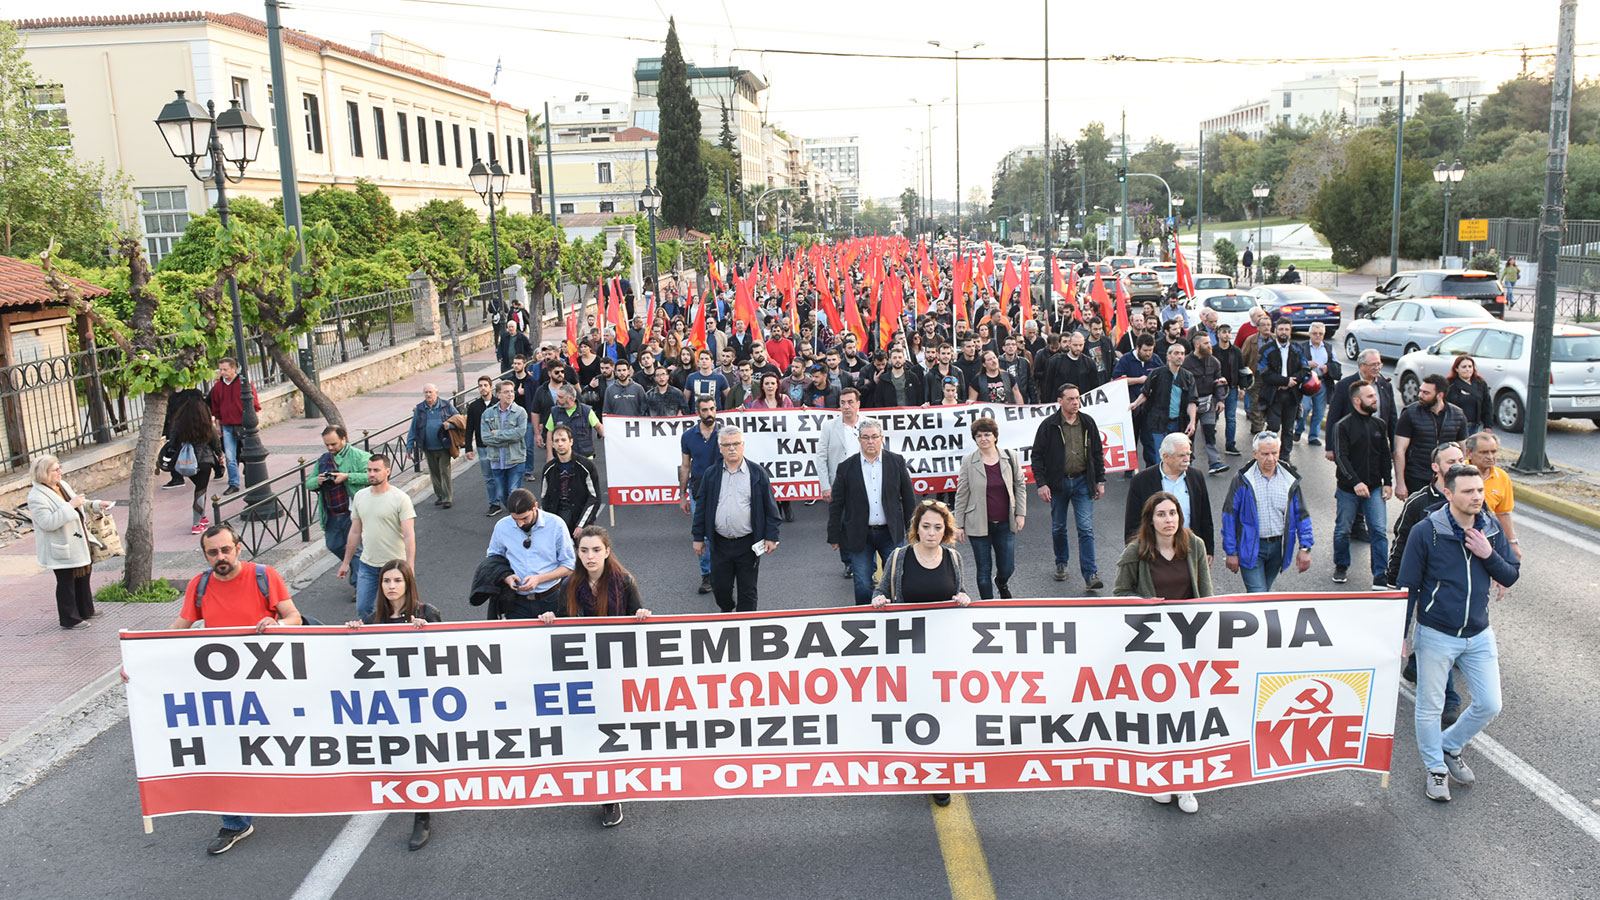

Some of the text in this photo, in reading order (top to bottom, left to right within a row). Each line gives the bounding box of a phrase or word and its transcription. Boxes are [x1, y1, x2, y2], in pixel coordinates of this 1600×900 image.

[625, 421, 640, 437] Η
[1004, 389, 1109, 421] ΕΓΚΛΜΑ
[901, 434, 963, 451] ΛΑΩΝ
[193, 607, 1333, 680] ΟΧΙ ΣΤΗΝ ΕΠΕΜΒΑΣΗ ΣΤΗ ΣΥΡΙΑ
[163, 691, 270, 728] ΗΠΑ
[330, 686, 467, 725] ΝΑΤΟ
[533, 681, 596, 716] ΕΕ
[622, 666, 907, 712] ΜΑΤΩΝΟΥΝ
[932, 670, 1046, 703] ΤΟΥΣ
[1072, 660, 1239, 703] ΛΑΟΥΣ
[170, 707, 1230, 767] Η ΚΥΒΕΡΝΗΣΗ ΣΤΗΡΙΖΕΙ ΤΟ ΕΓΚΛΗΜΑ
[1255, 715, 1364, 770] ΚΚΕ
[370, 753, 1234, 804] ΚΟΜΜΑΤΙΚΗ ΟΡΓΑΝΩΣΗ ΑΤΤΙΚΗΣ
